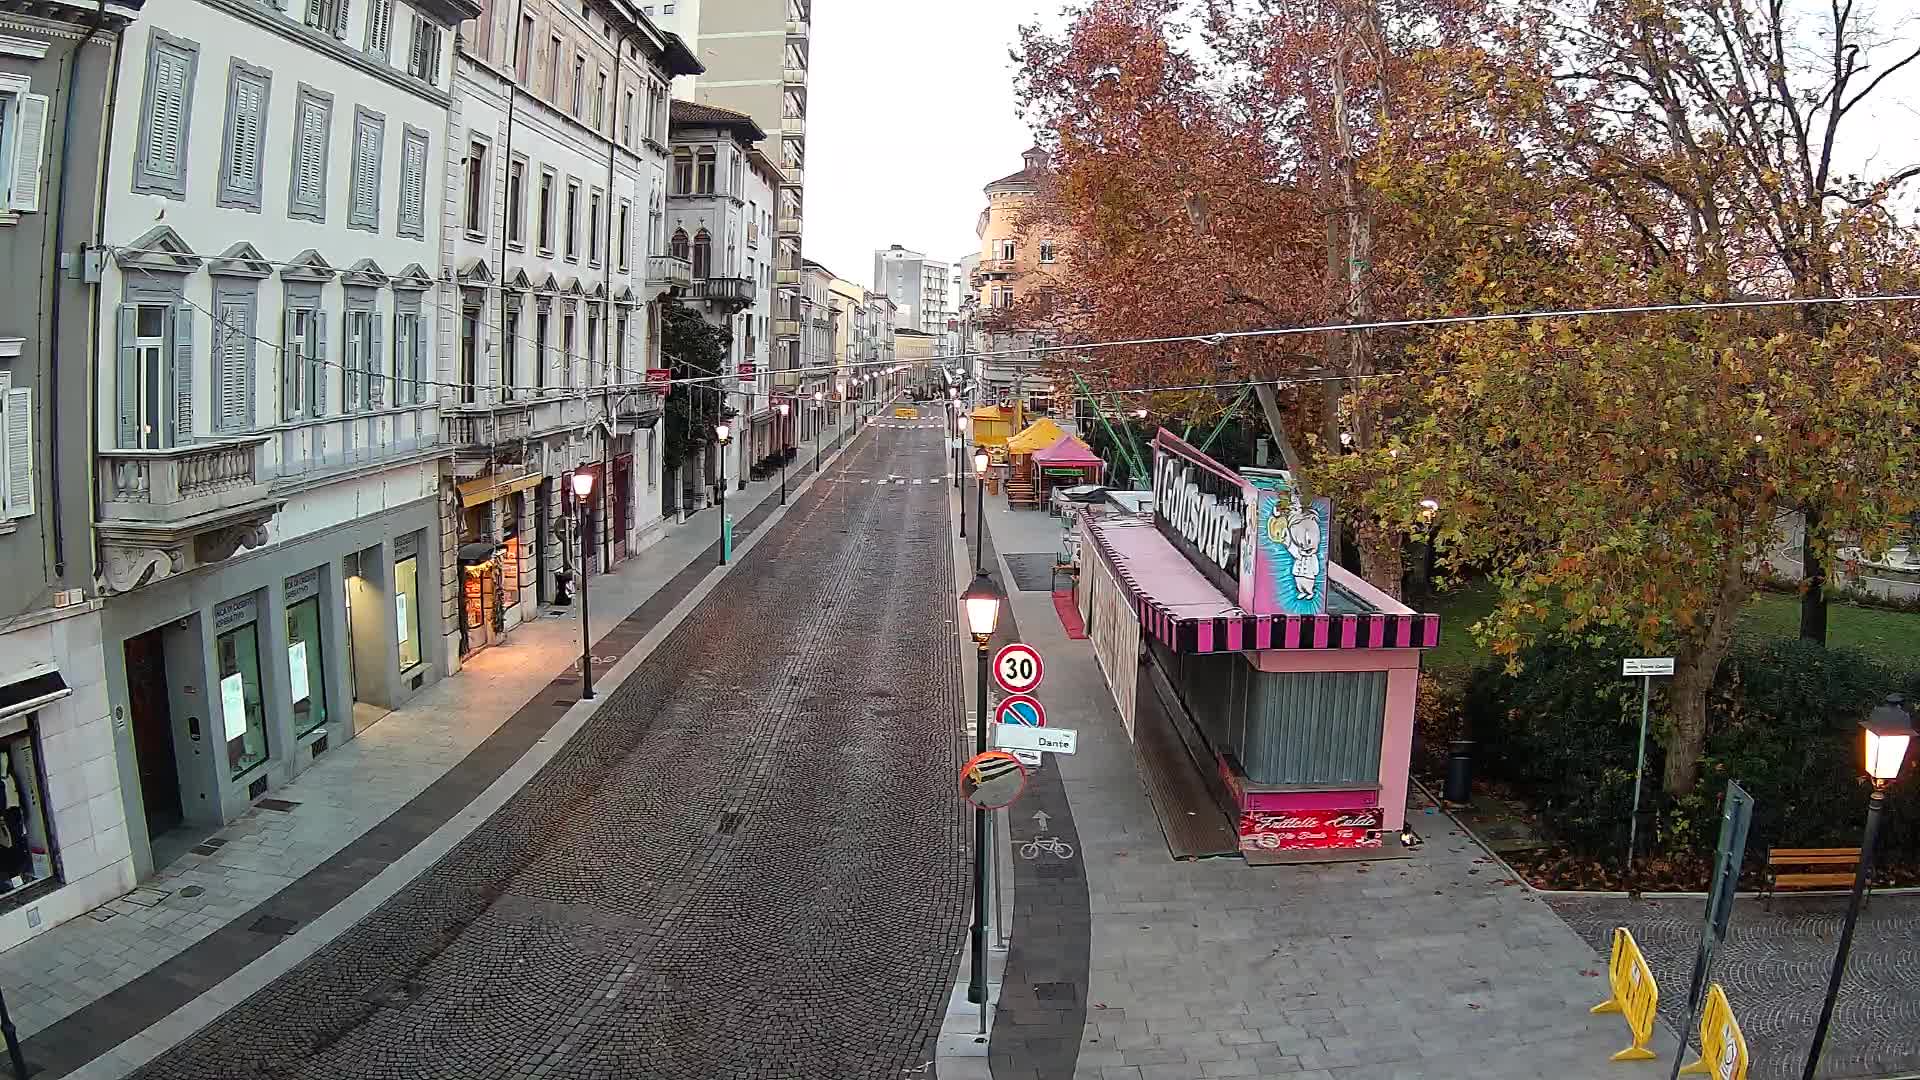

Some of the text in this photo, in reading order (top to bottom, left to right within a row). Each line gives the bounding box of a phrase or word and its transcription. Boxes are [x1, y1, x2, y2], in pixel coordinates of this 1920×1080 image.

[1163, 459, 1233, 570] Golosone
[1005, 657, 1033, 680] 30
[1038, 737, 1070, 749] Dante
